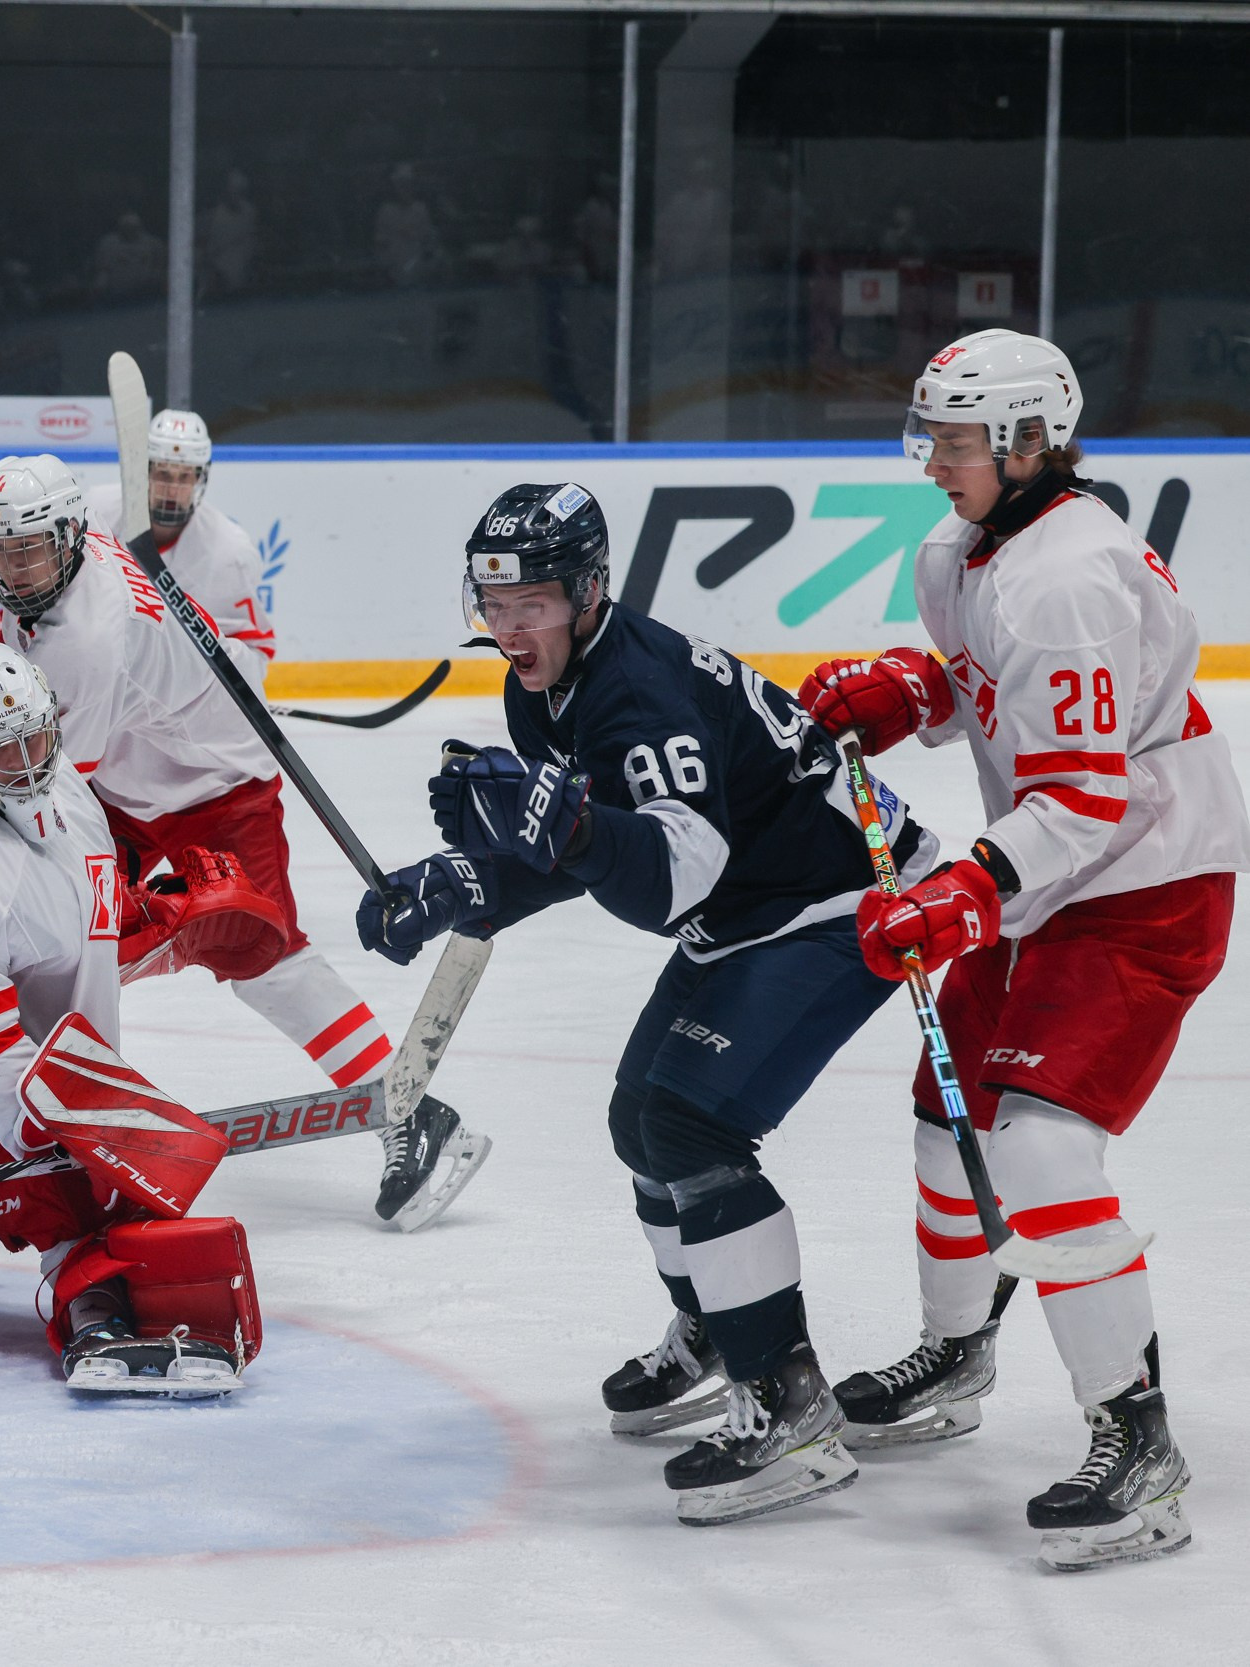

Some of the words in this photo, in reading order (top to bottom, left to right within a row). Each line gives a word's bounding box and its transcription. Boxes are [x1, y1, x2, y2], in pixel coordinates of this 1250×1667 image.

[1008, 396, 1044, 410] CCM
[487, 517, 520, 537] 86
[1049, 667, 1117, 736] 28
[624, 735, 707, 806] 86
[34, 811, 46, 838] 1
[1123, 1467, 1147, 1505] BAUER
